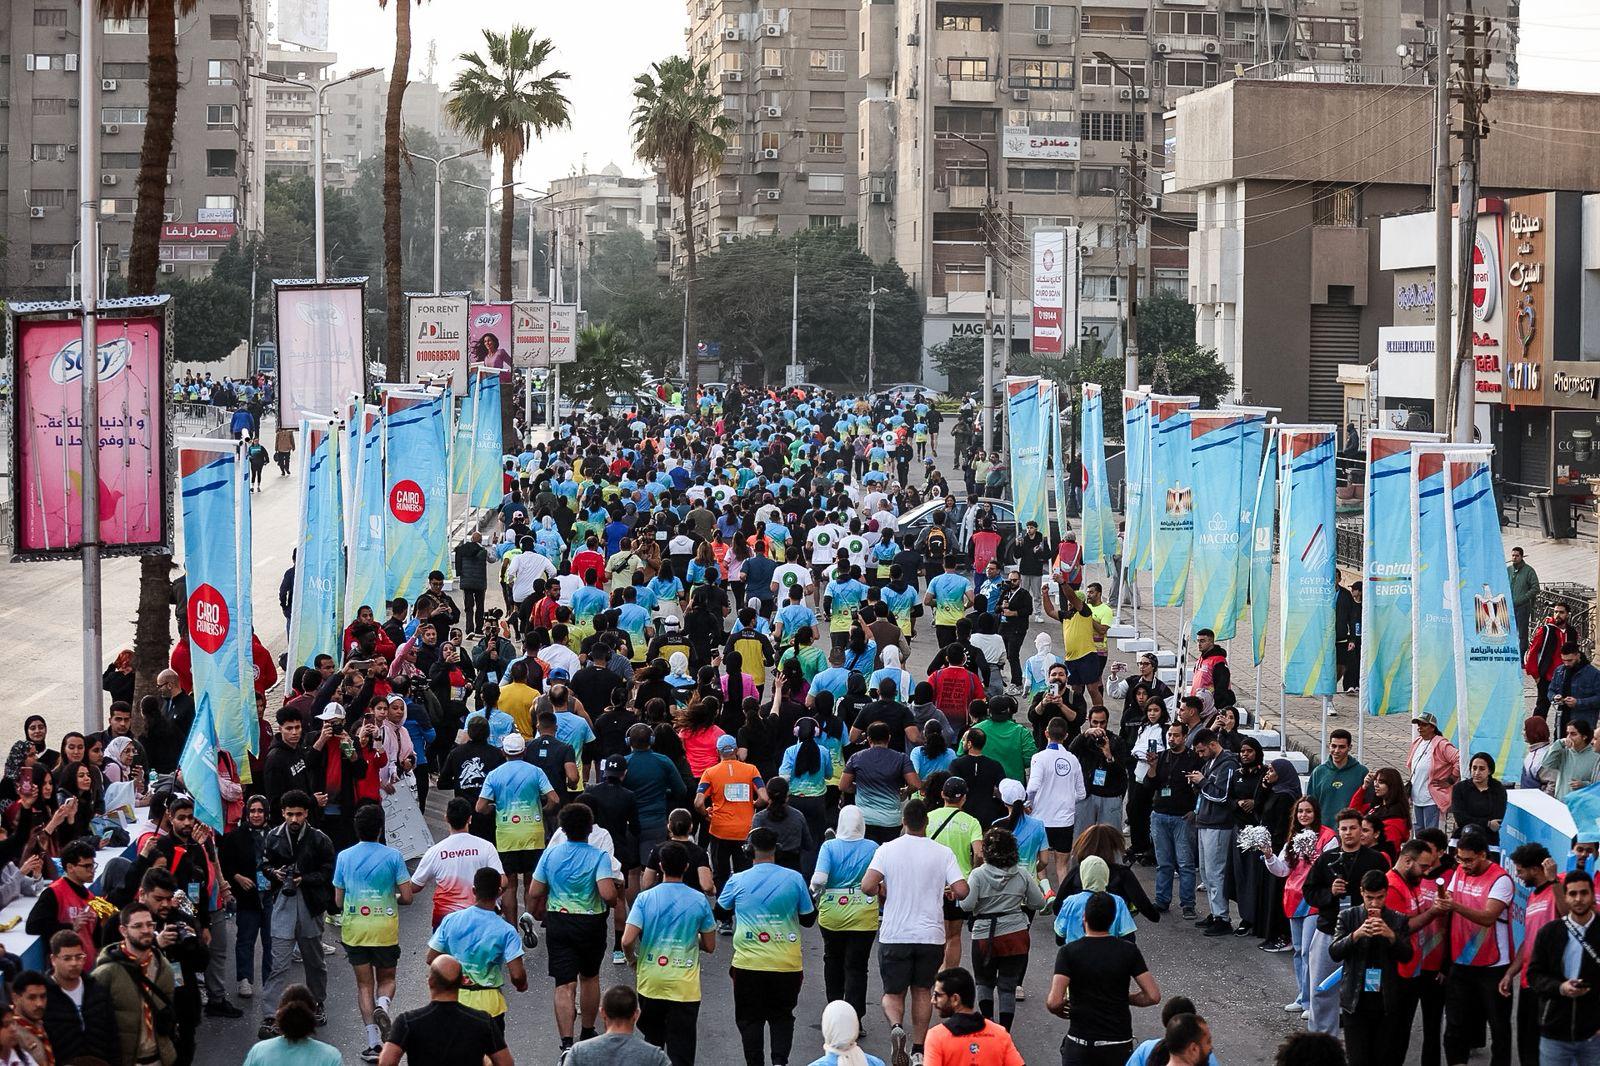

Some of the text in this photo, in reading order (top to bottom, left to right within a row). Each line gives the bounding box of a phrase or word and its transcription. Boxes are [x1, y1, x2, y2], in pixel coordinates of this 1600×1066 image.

[1510, 211, 1540, 239] صيدلية
[190, 226, 218, 238] معمل
[1035, 289, 1061, 298] CAIRO SCAN
[417, 305, 460, 314] FOR RENT
[478, 316, 496, 325] SOFY
[416, 350, 461, 362] 01006885300
[1553, 372, 1596, 399] Pharmacy
[396, 490, 420, 505] CAIRO
[396, 502, 421, 513] RUNNERS
[1199, 531, 1239, 546] MACRO
[1470, 646, 1494, 655] والرياضة
[440, 848, 479, 860] Dewan
